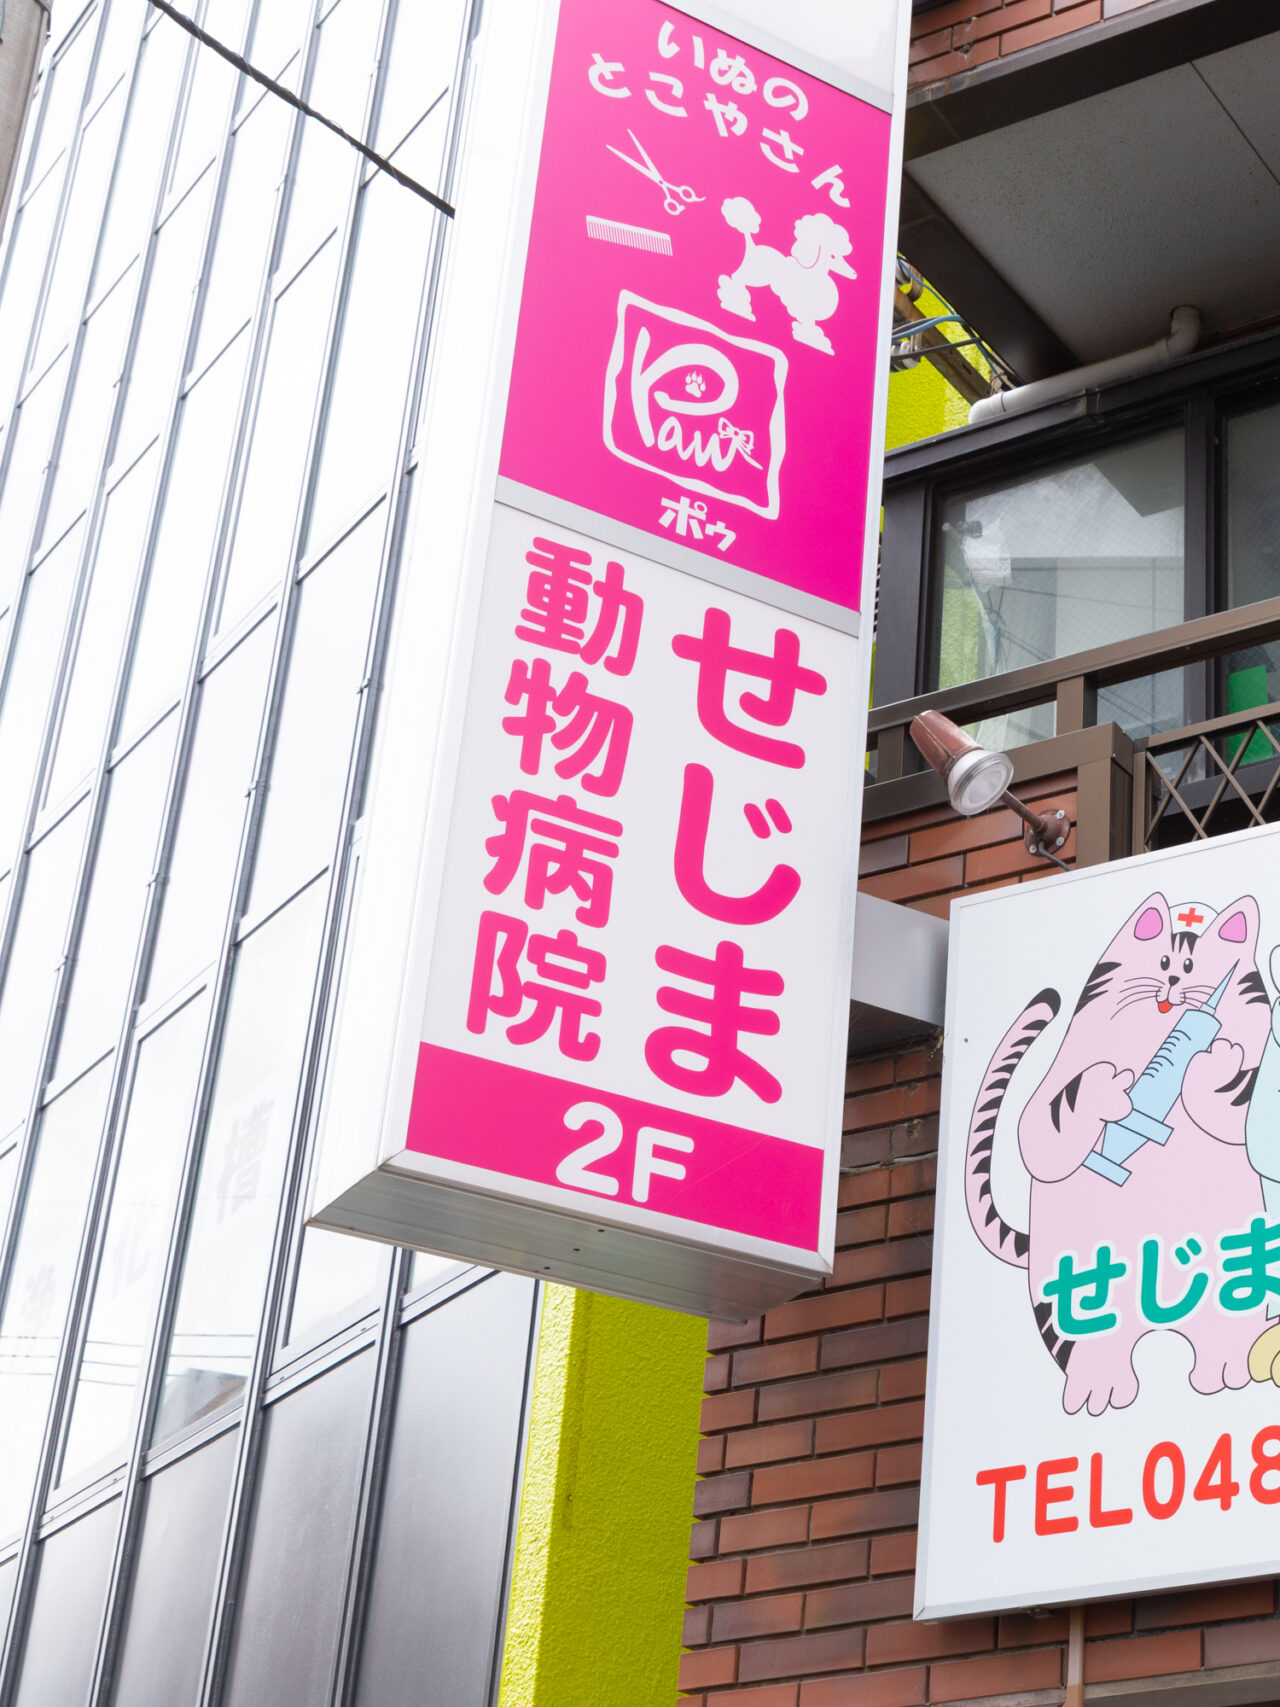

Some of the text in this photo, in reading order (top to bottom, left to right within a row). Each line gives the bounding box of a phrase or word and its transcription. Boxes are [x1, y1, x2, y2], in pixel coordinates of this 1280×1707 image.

[587, 52, 851, 208] とこやさん
[657, 19, 809, 121] いぬの
[630, 326, 760, 472] Paw
[465, 536, 644, 1063] 動物病院
[642, 607, 828, 1104] せじま
[555, 1101, 695, 1203] 2F
